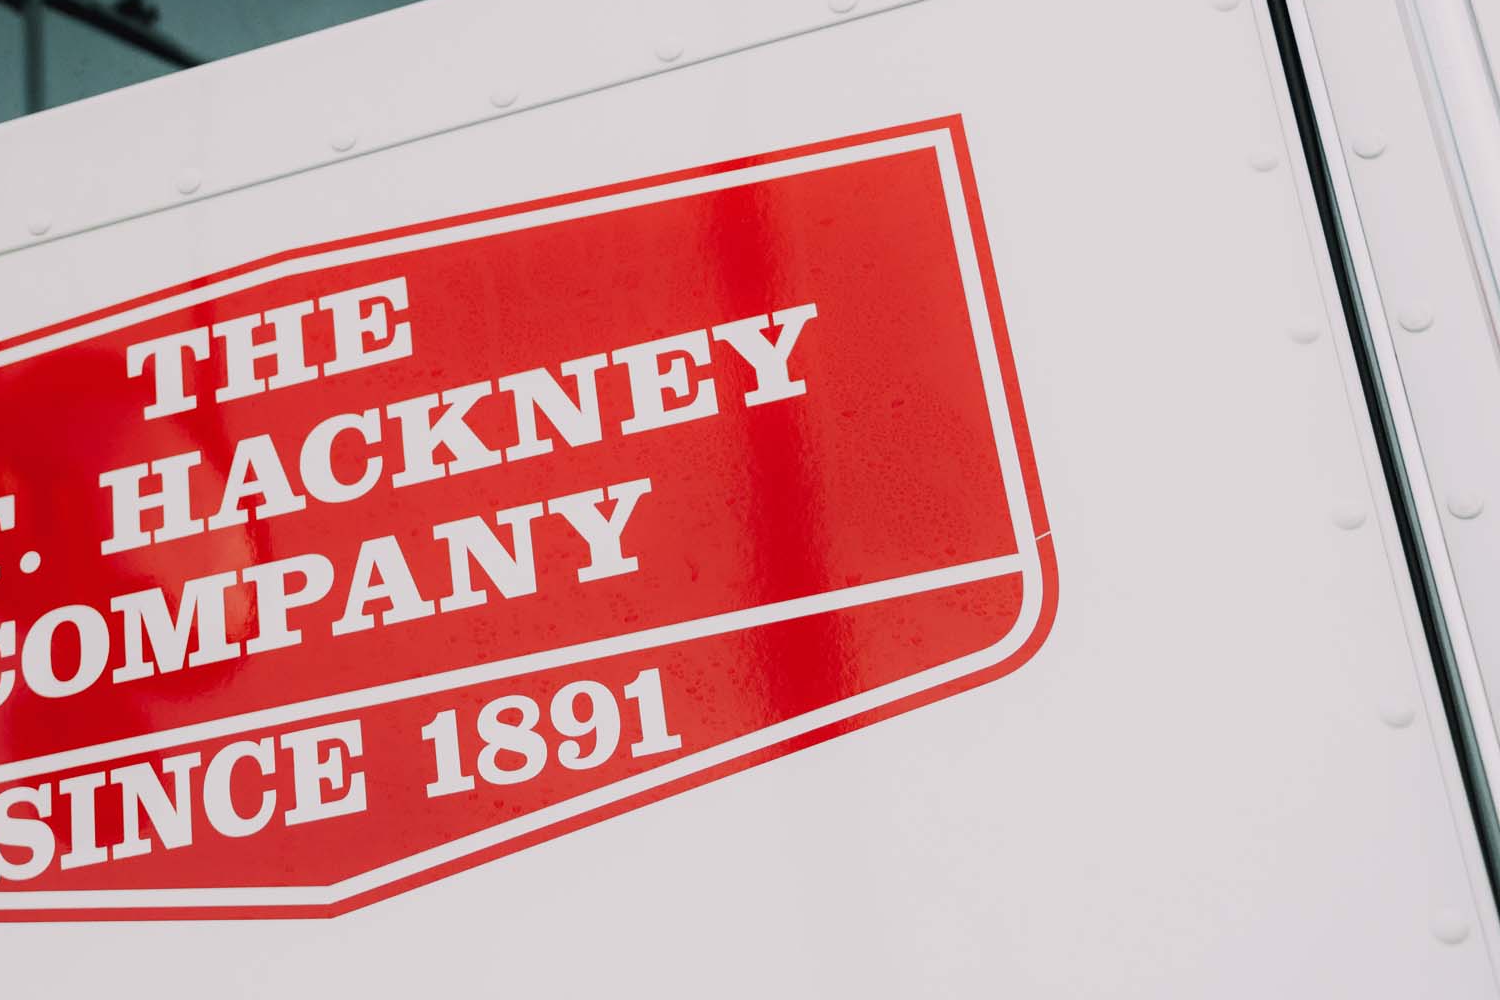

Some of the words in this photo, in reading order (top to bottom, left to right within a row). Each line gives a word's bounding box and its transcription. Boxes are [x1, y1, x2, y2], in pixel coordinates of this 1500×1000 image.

[126, 277, 413, 420] THE
[99, 303, 818, 555] HACKNEY
[421, 667, 682, 798] 1891
